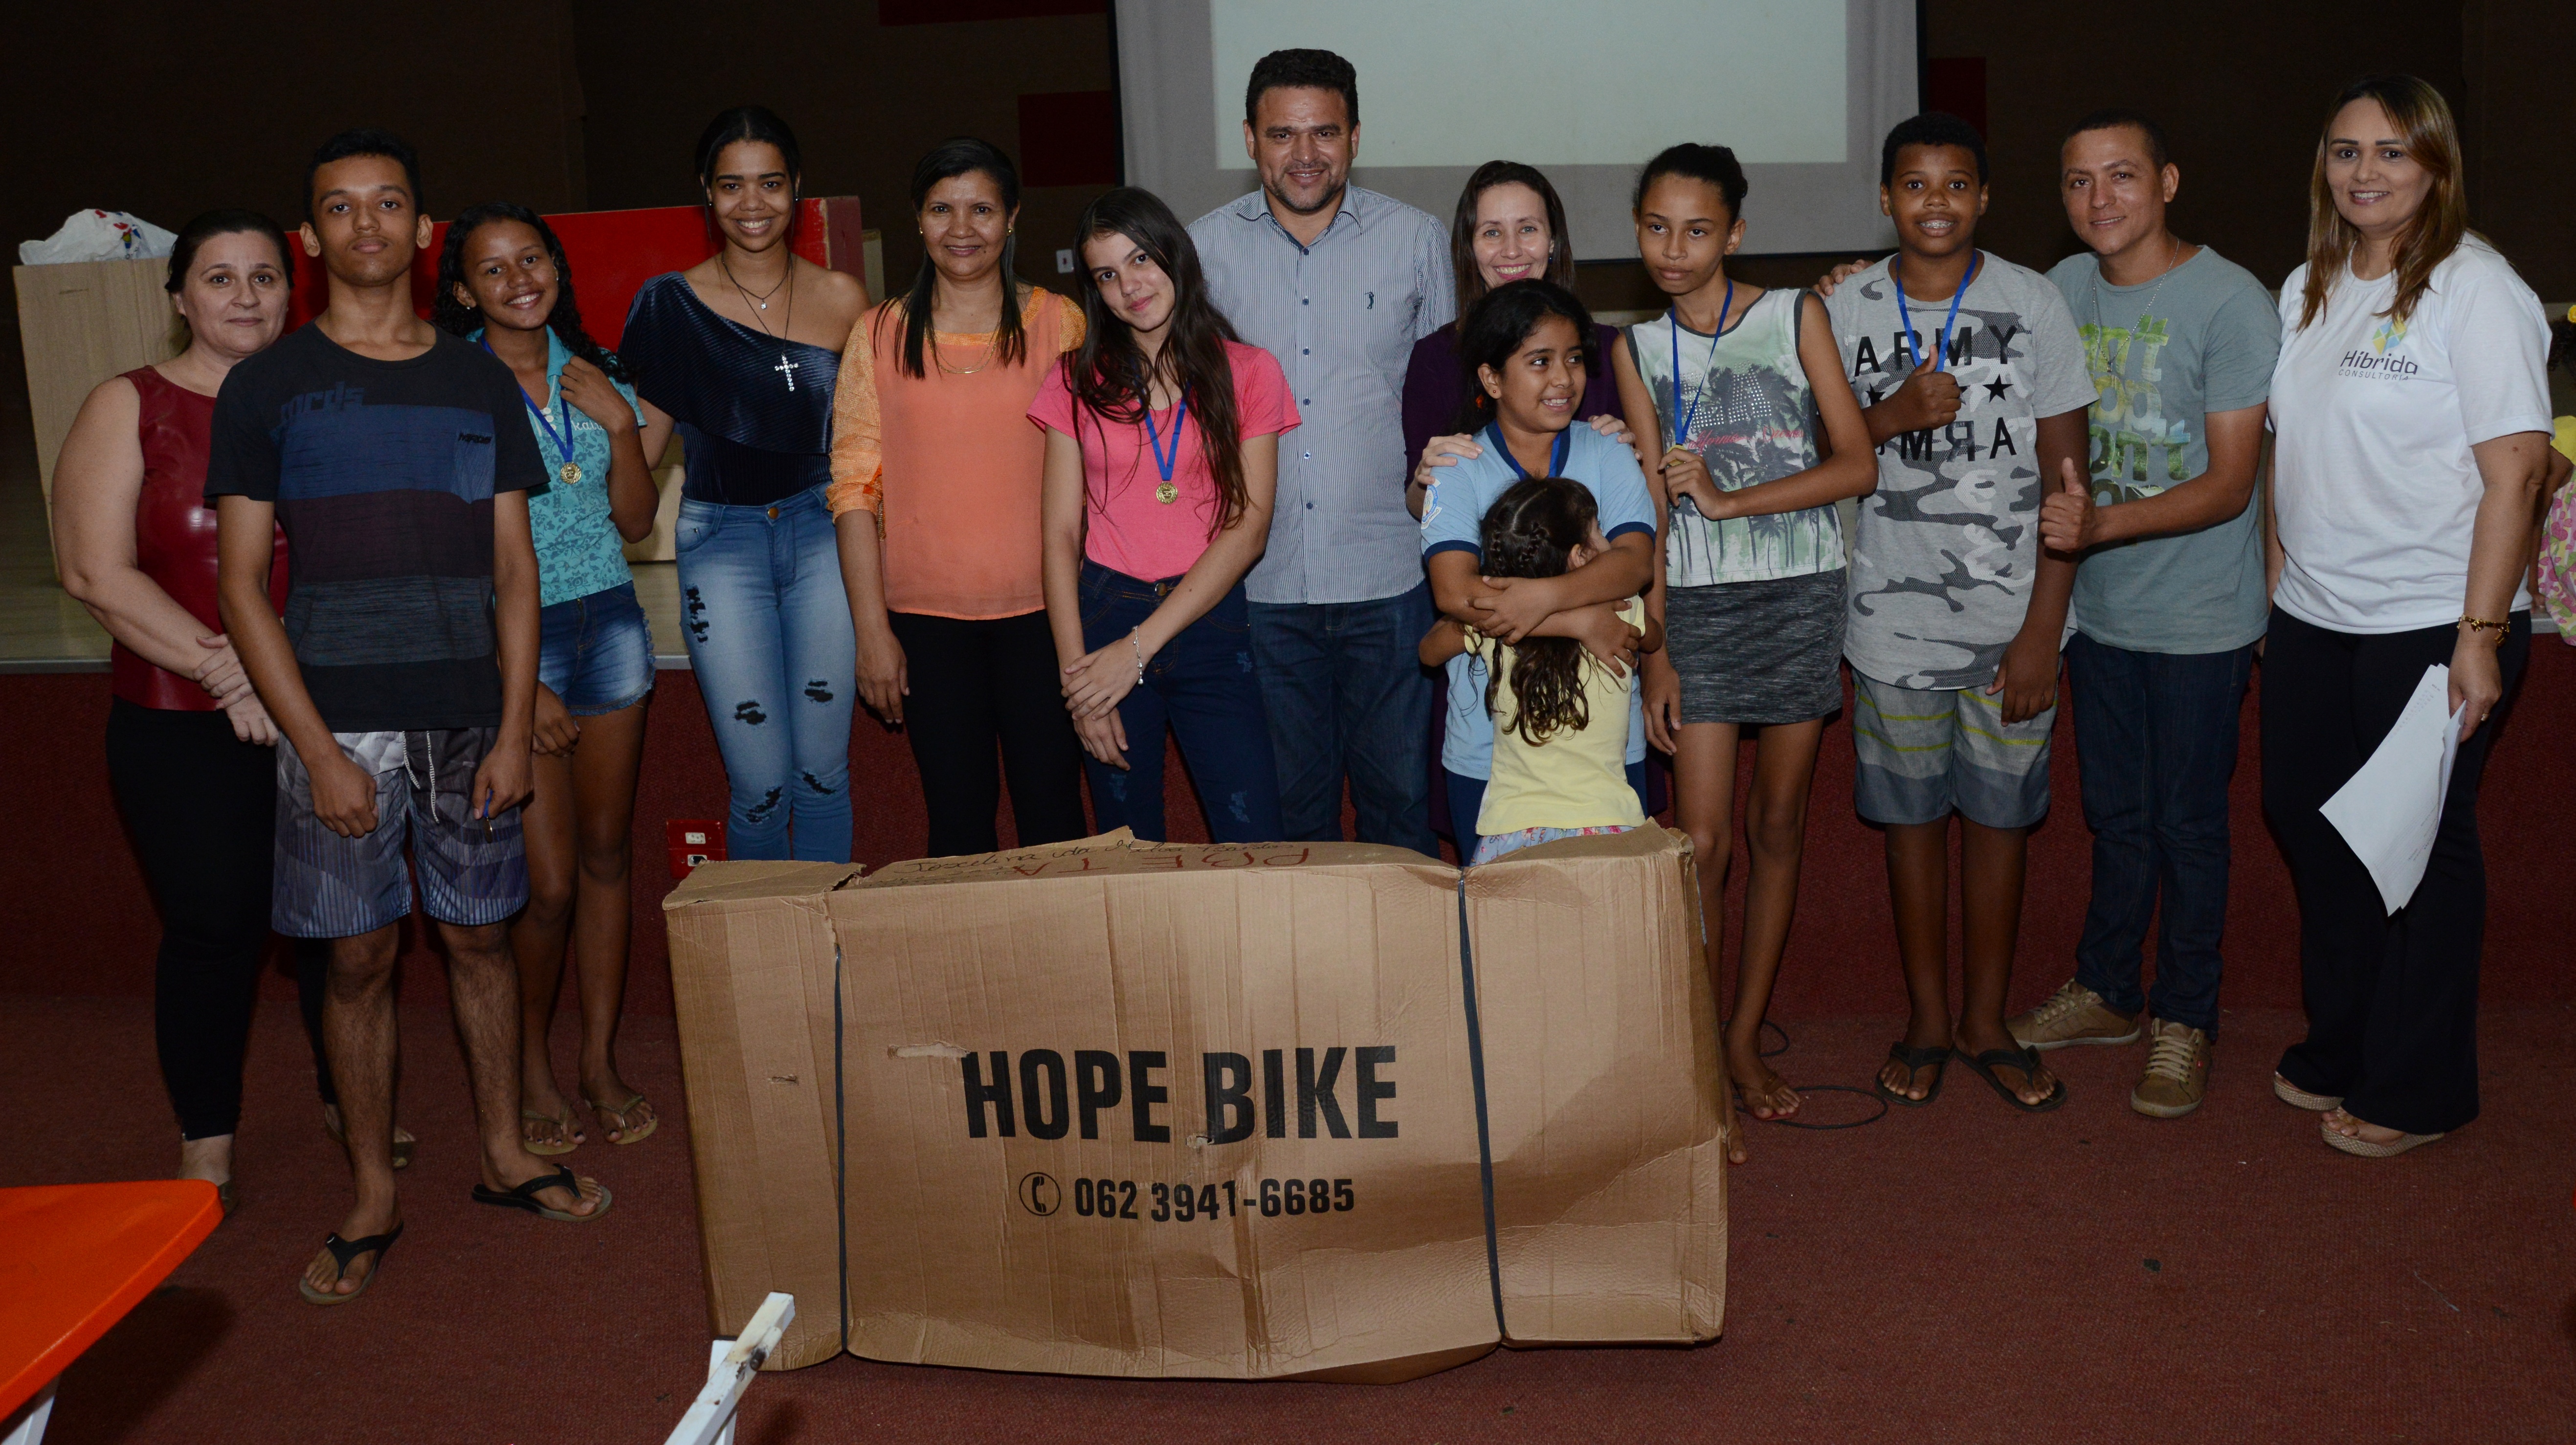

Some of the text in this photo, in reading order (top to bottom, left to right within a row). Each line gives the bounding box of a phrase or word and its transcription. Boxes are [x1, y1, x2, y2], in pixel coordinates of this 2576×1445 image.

[1854, 325, 2018, 377] ARMY
[2340, 350, 2418, 375] Híbrida
[2338, 369, 2409, 381] CONSULTORIA
[961, 1045, 1398, 1145] HOPE BIKE
[1076, 1178, 1355, 1223] 062 3941-6685
